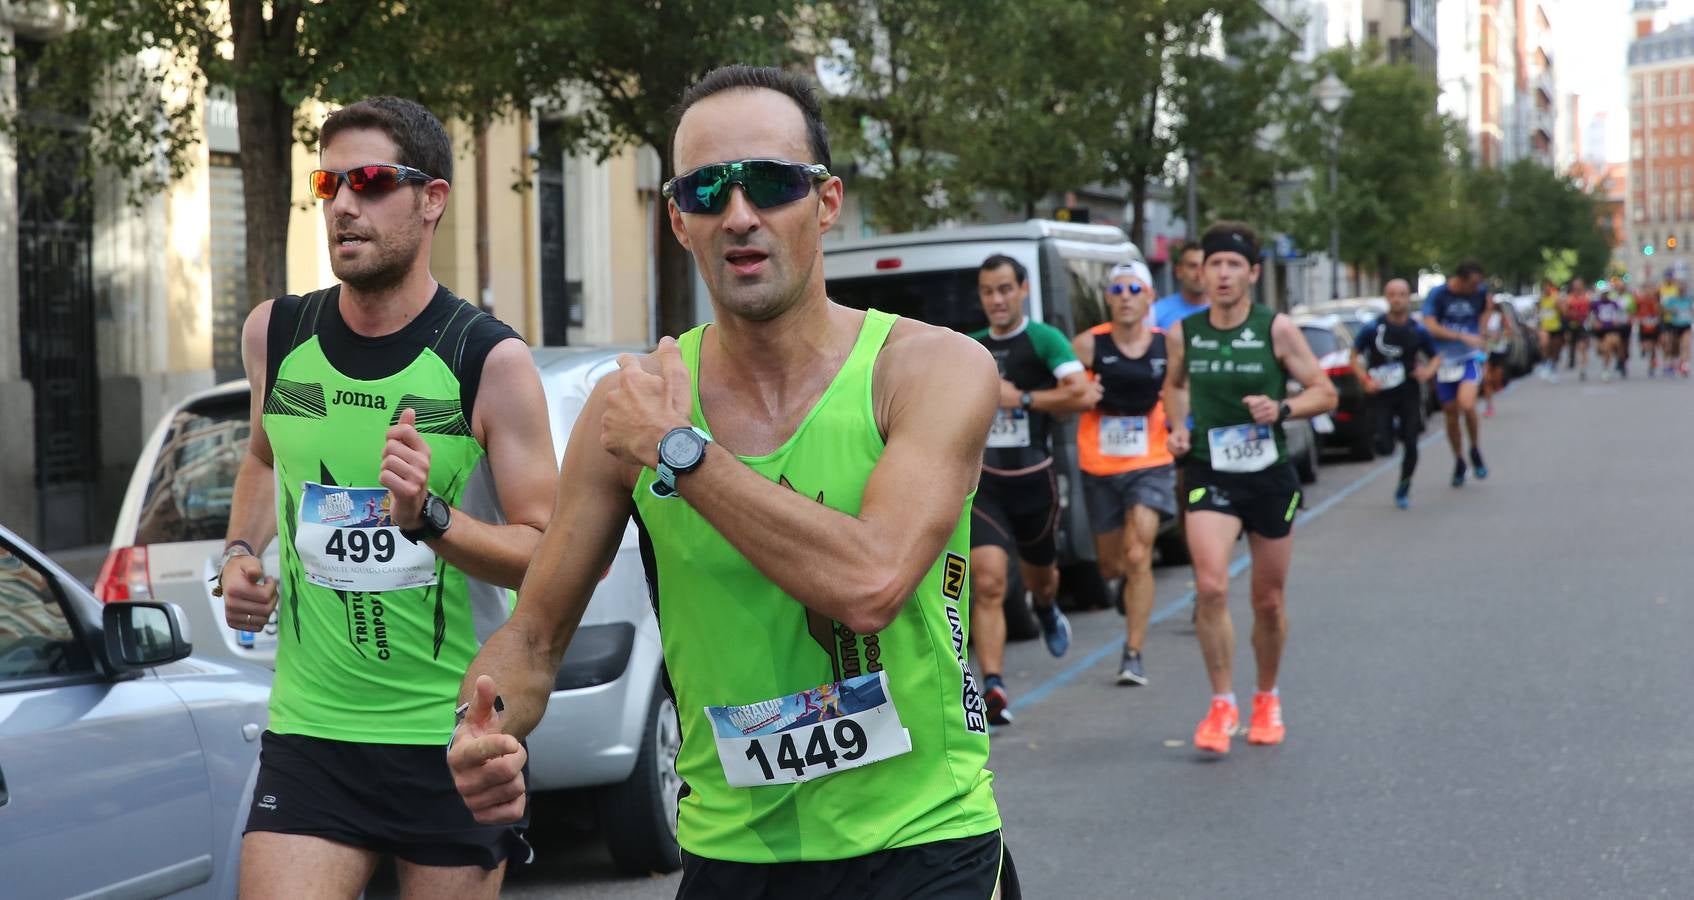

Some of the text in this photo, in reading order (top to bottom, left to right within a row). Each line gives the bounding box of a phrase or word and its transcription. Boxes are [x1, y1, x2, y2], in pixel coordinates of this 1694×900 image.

[1223, 439, 1265, 460] 1305
[325, 491, 351, 505] MEDIA
[325, 529, 396, 563] 499
[947, 562, 962, 592] IN
[745, 718, 868, 781] 1449
